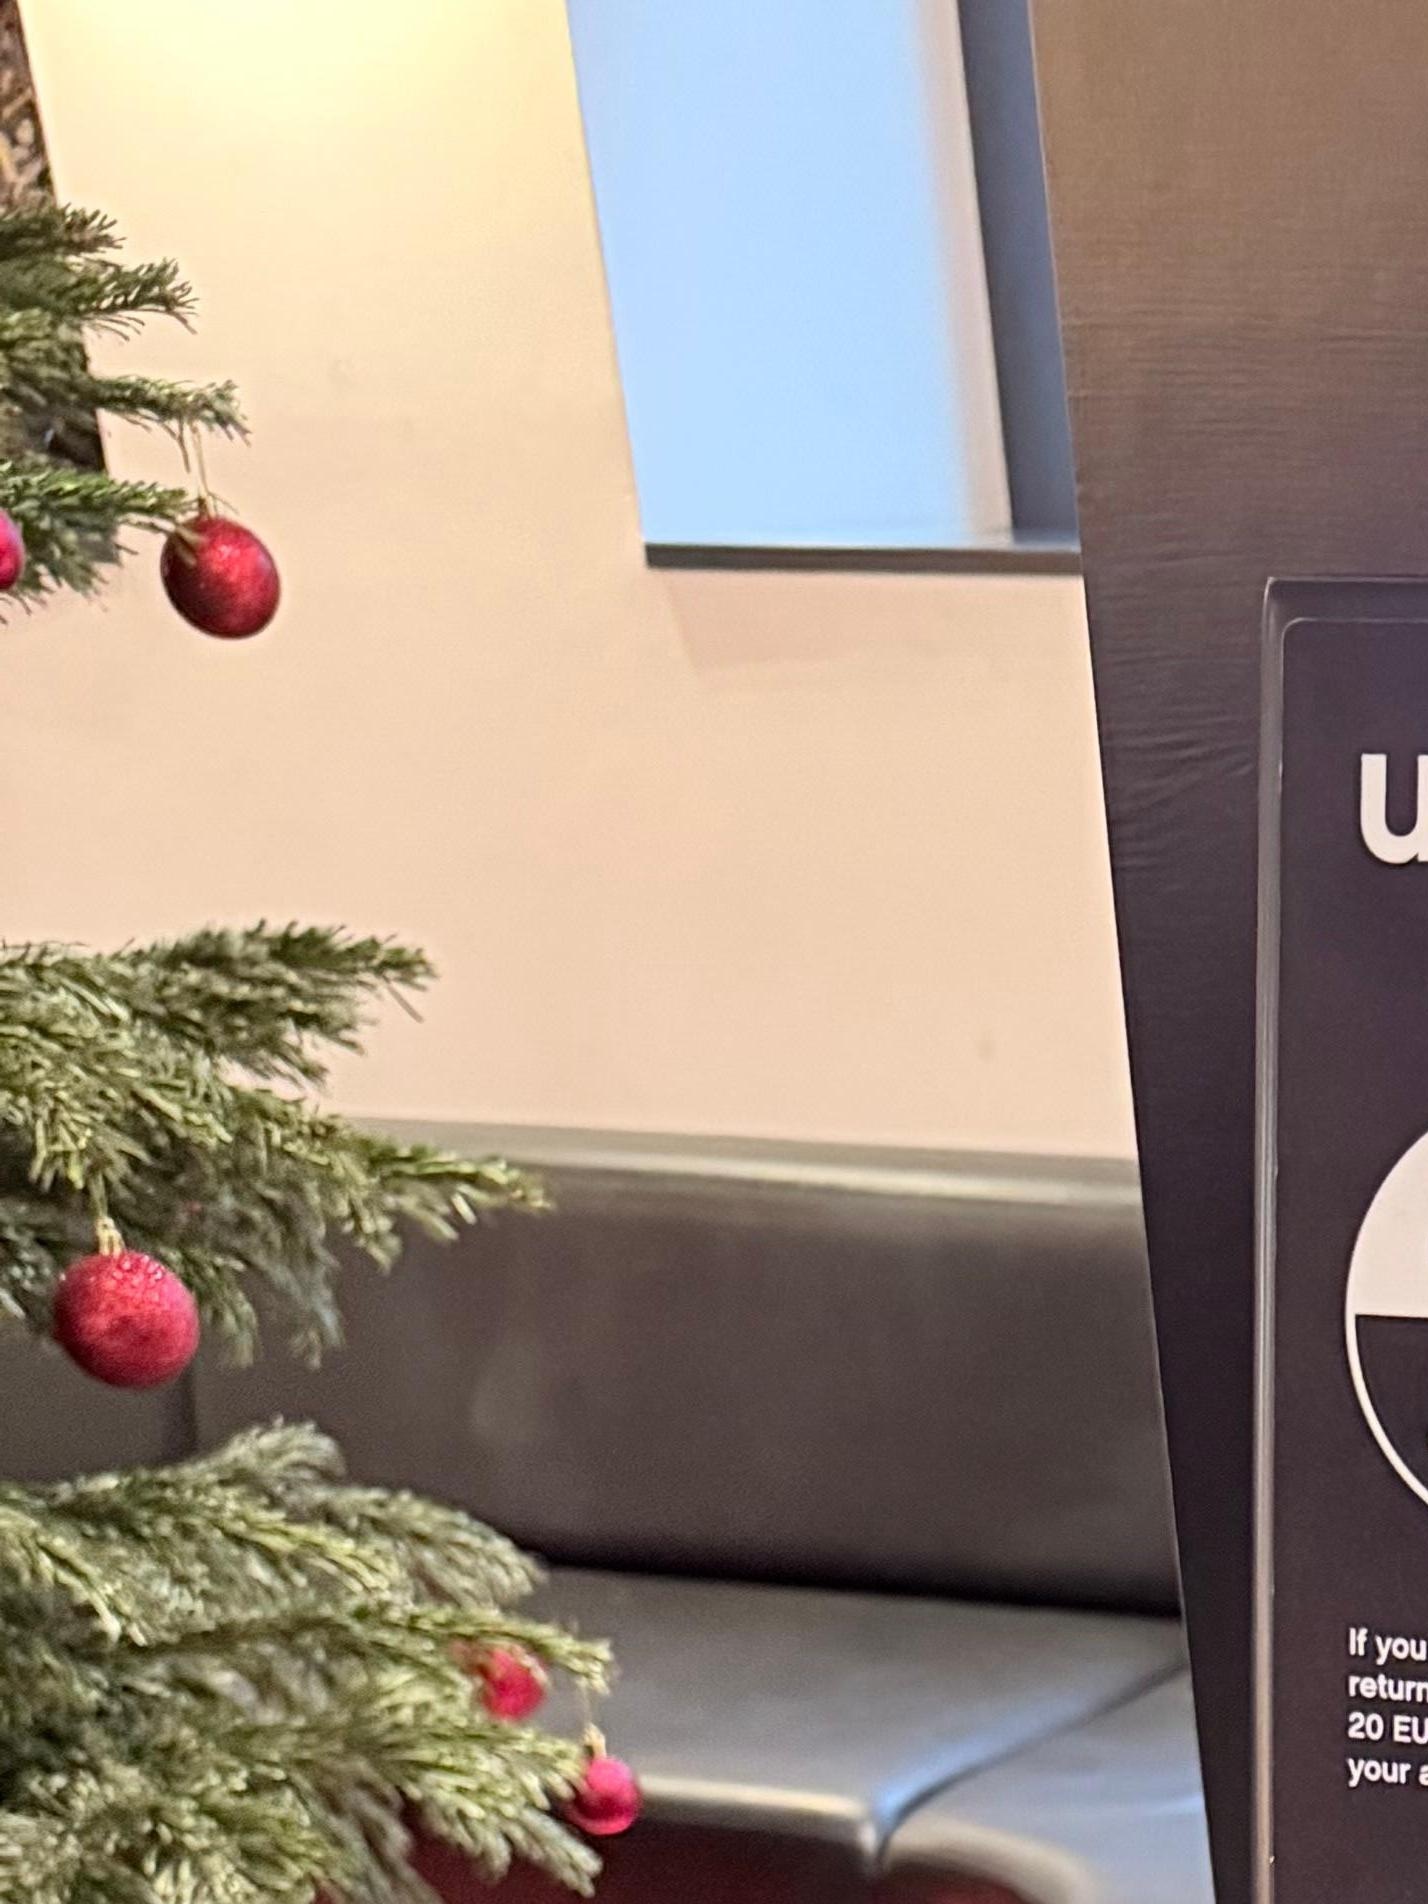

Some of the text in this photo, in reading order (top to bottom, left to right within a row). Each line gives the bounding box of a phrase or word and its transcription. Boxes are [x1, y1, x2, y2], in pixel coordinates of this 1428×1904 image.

[1349, 1627, 1368, 1656] If
[1375, 1635, 1427, 1666] you
[1348, 1711, 1384, 1741] 20
[1347, 1758, 1412, 1788] your
